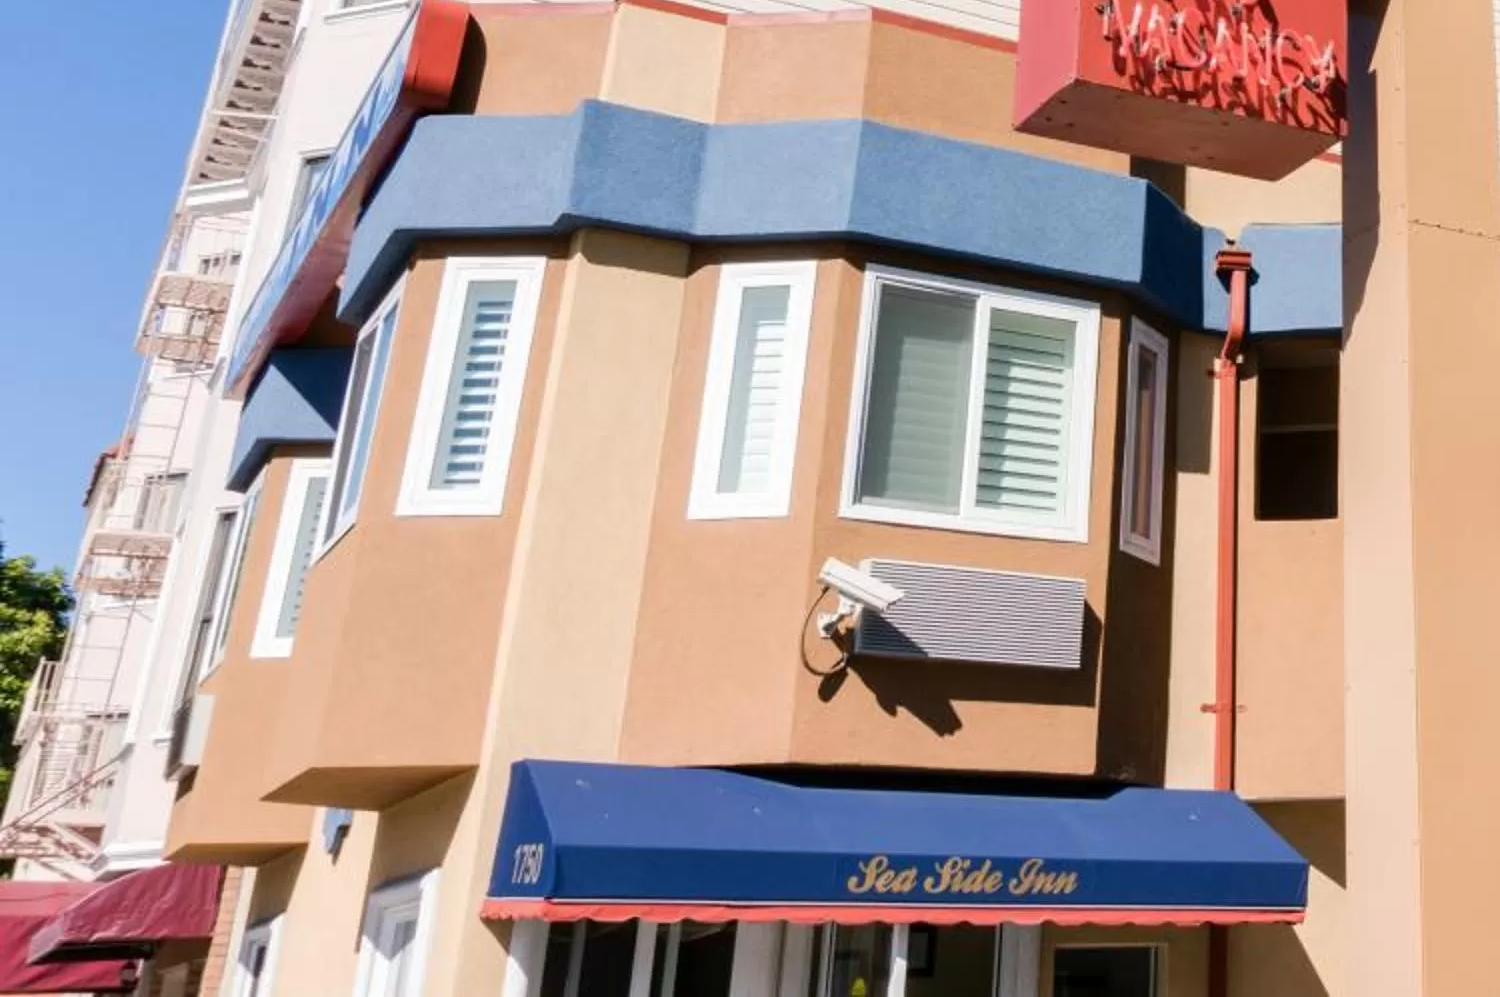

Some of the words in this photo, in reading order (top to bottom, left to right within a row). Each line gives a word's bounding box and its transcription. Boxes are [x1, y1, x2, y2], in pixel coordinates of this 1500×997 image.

[848, 855, 918, 894] Sea
[923, 856, 1004, 894] Side
[1008, 858, 1078, 896] Inn
